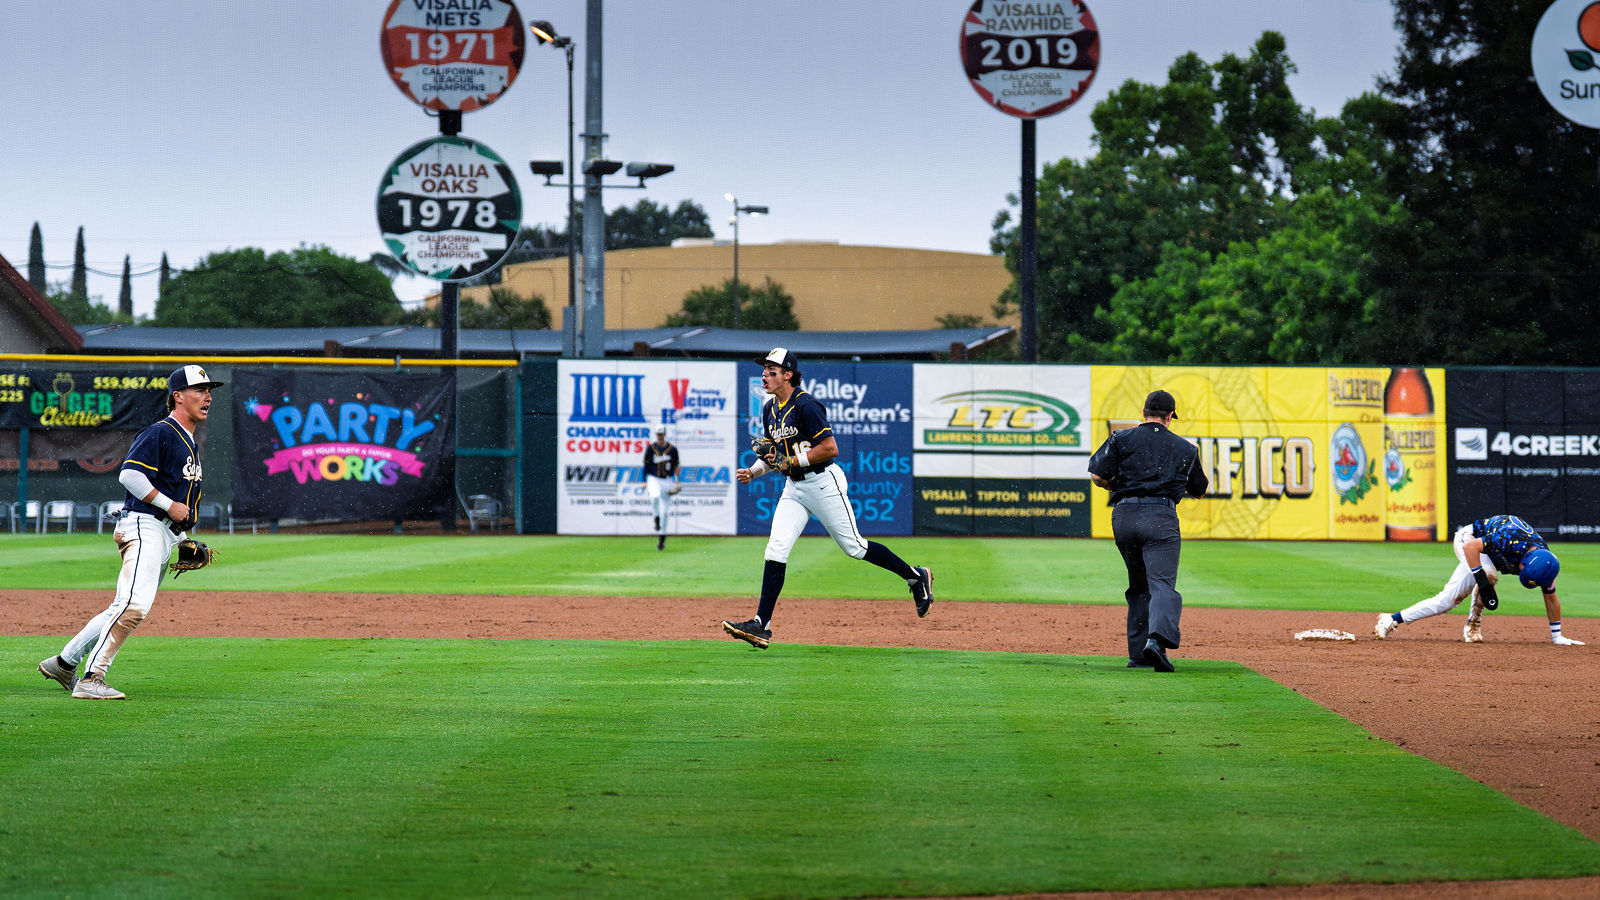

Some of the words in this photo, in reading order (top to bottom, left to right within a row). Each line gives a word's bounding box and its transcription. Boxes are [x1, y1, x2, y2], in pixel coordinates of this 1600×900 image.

[414, 0, 492, 10] VISALIA
[993, 3, 1065, 17] VISALIA
[426, 12, 481, 26] METS
[985, 17, 1074, 31] RAWHIDE
[405, 32, 495, 60] 1971
[980, 38, 1078, 67] 2019
[422, 67, 485, 76] CALIFORNIA
[1001, 72, 1062, 81] CALIFORNIA
[433, 75, 474, 84] LEAGUE
[1011, 80, 1051, 88] LEAGUE
[422, 83, 486, 92] CHAMPIONS
[1001, 88, 1064, 97] CHAMPIONS
[409, 163, 489, 178] VISALIA
[421, 180, 478, 193] OAKS
[398, 200, 498, 229] 1978
[418, 234, 480, 243] CALIFORNIA
[428, 242, 470, 251] LEAGUE
[417, 250, 481, 259] CHAMPIONS
[93, 376, 169, 390] 559.967.40
[668, 378, 726, 410] Victory
[800, 378, 868, 404] Valley
[948, 405, 1043, 428] LTC
[271, 402, 435, 450] PARTY
[566, 426, 650, 438] CHARACTER
[928, 432, 983, 443] LAWRENCE
[986, 433, 1032, 444] TRACTOR
[1057, 434, 1078, 445] INC.
[1491, 431, 1600, 456] 4CREEK
[337, 446, 359, 455] PARTY
[368, 449, 392, 459] FAVOR
[859, 451, 911, 474] Kids
[289, 454, 400, 486] WORKS
[848, 481, 903, 499] ounty
[921, 489, 967, 501] VISALIA
[977, 490, 1020, 502] TIPTON
[1028, 491, 1086, 503] HANFORD
[850, 498, 895, 521] 952
[934, 505, 1071, 517] www.lawrencetractor.com
